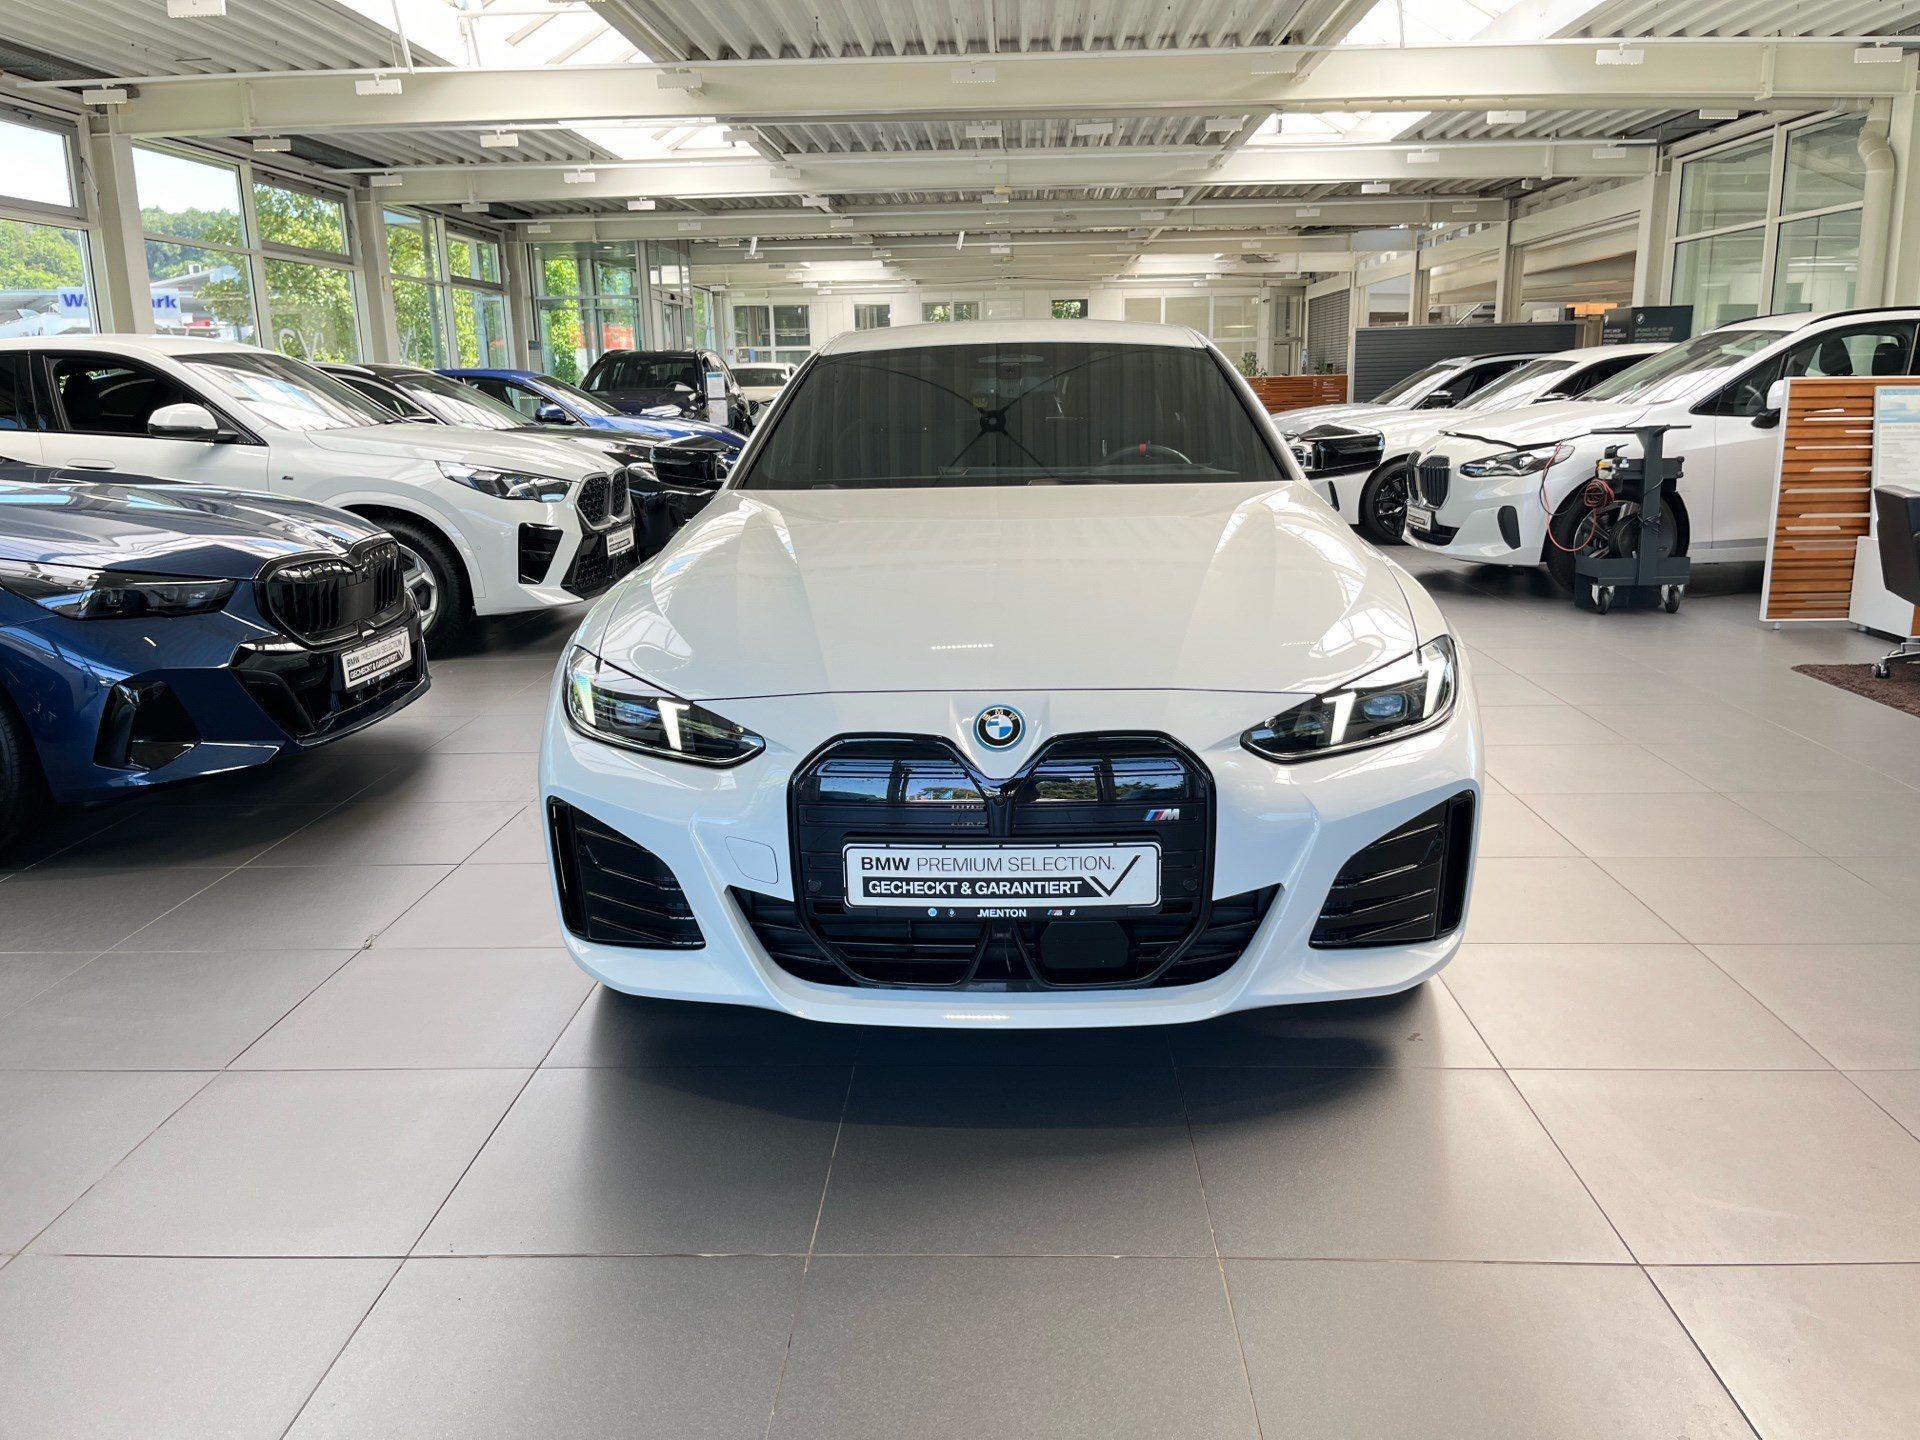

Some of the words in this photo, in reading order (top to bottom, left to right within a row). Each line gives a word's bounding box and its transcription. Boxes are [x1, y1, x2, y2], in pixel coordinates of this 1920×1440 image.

[982, 708, 1018, 721] BMW
[861, 856, 911, 871] BMW
[917, 857, 1002, 872] PREMIUM
[1008, 855, 1115, 872] SELECTION.
[868, 880, 958, 895] GECHECKT
[960, 881, 972, 895] &
[975, 880, 1083, 895] GARANTIERT
